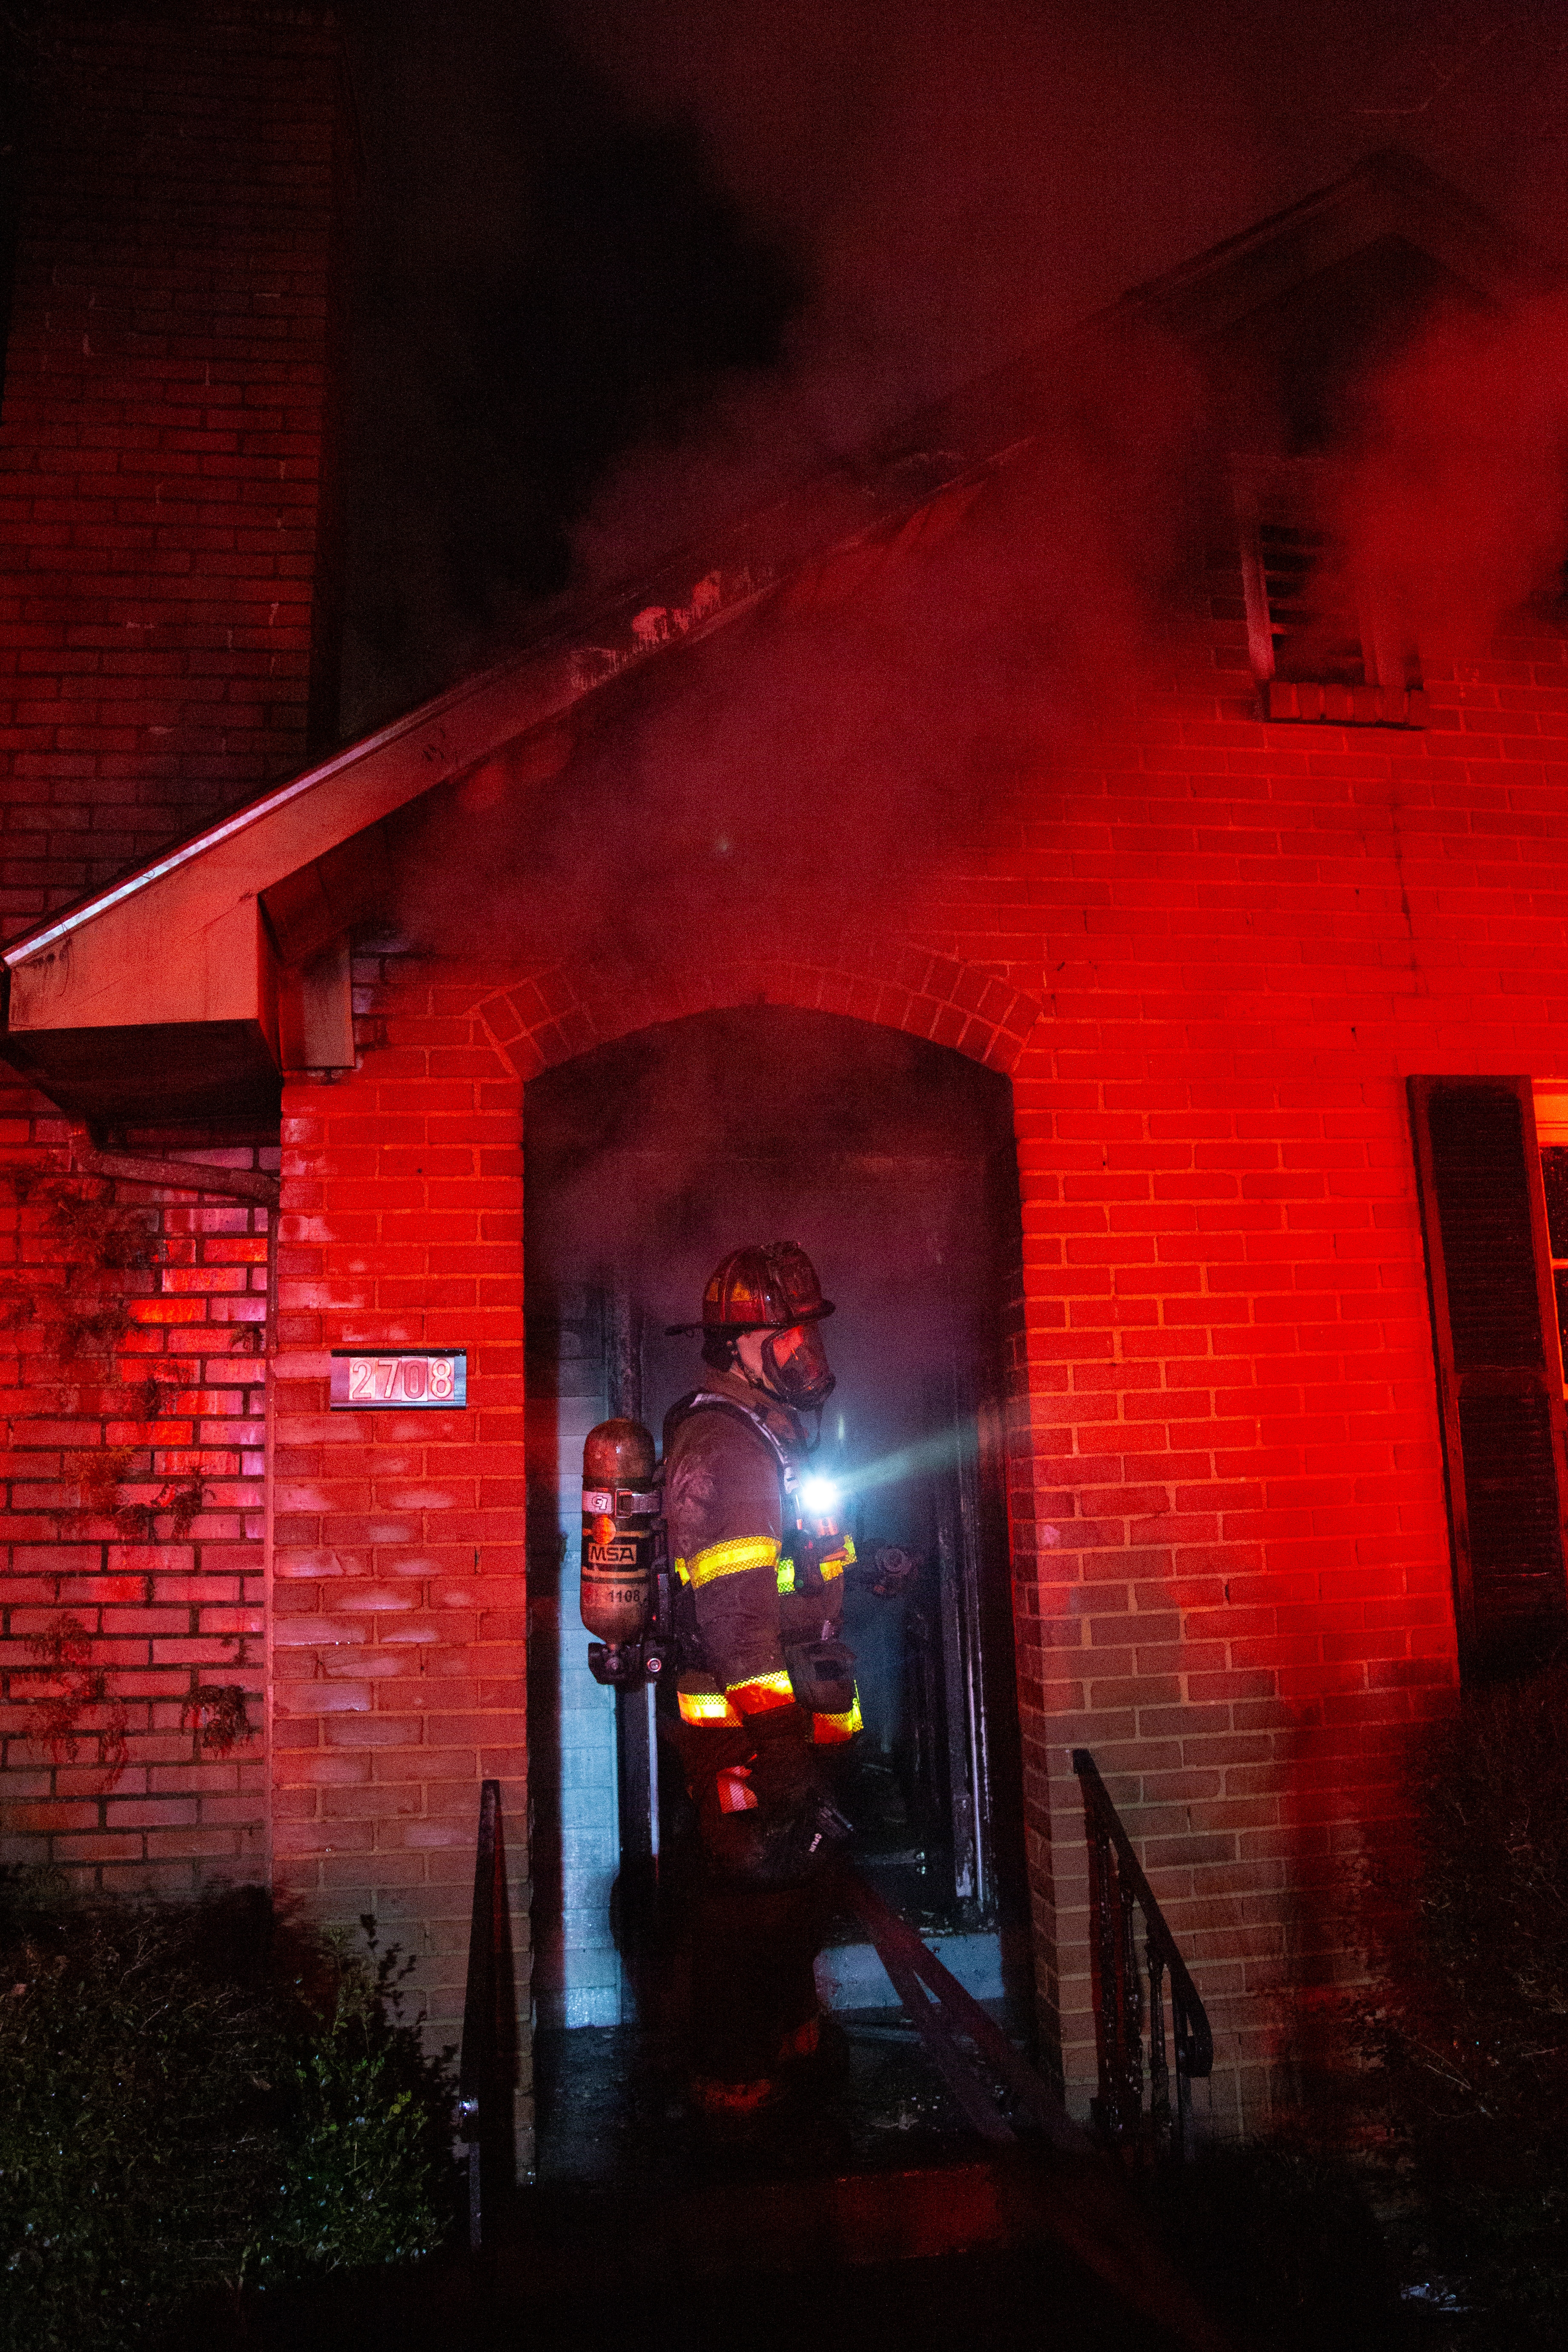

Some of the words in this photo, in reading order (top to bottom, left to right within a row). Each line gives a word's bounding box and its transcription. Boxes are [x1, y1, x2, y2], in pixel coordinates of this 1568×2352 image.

[353, 1359, 452, 1399] 2708
[592, 1495, 608, 1510] G1
[591, 1546, 634, 1561] MSA
[608, 1589, 640, 1603] 1108
